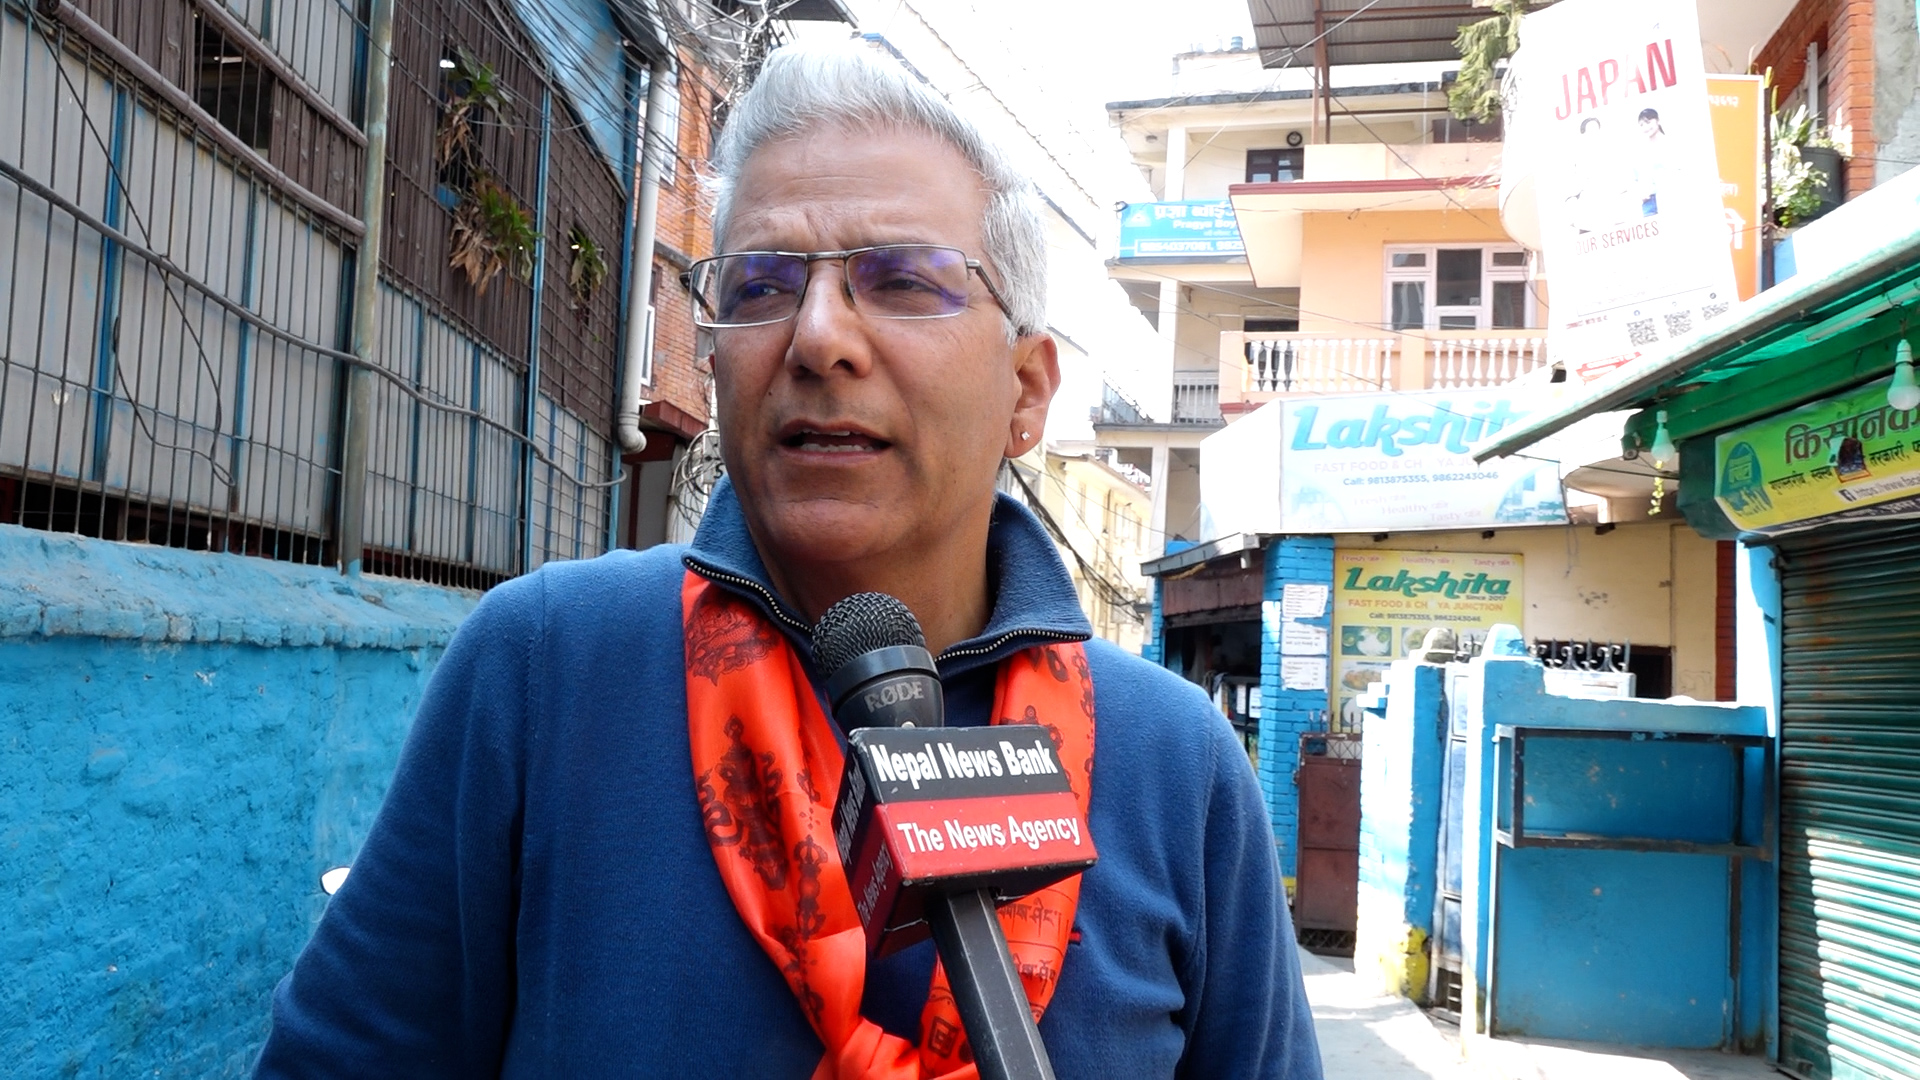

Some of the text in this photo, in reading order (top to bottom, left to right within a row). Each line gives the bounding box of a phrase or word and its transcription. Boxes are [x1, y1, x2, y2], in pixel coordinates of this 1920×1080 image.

[1555, 39, 1677, 121] JAPAN
[1173, 220, 1213, 230] Pragya
[1602, 220, 1660, 249] SERVICES
[1291, 399, 1532, 457] Lakshit
[1314, 462, 1346, 473] FAST
[1350, 460, 1388, 471] FOOD
[1392, 460, 1400, 469] &
[1343, 472, 1499, 486] Call: 9813875355, 9862243046
[1343, 567, 1511, 600] Lakshita
[1348, 599, 1372, 608] FAST
[1375, 599, 1404, 608] FOOD
[1453, 603, 1504, 611] JUNCTION
[864, 681, 924, 713] RØDE
[869, 740, 1059, 790] Nepal News Bank
[897, 815, 1080, 854] The News Agency
